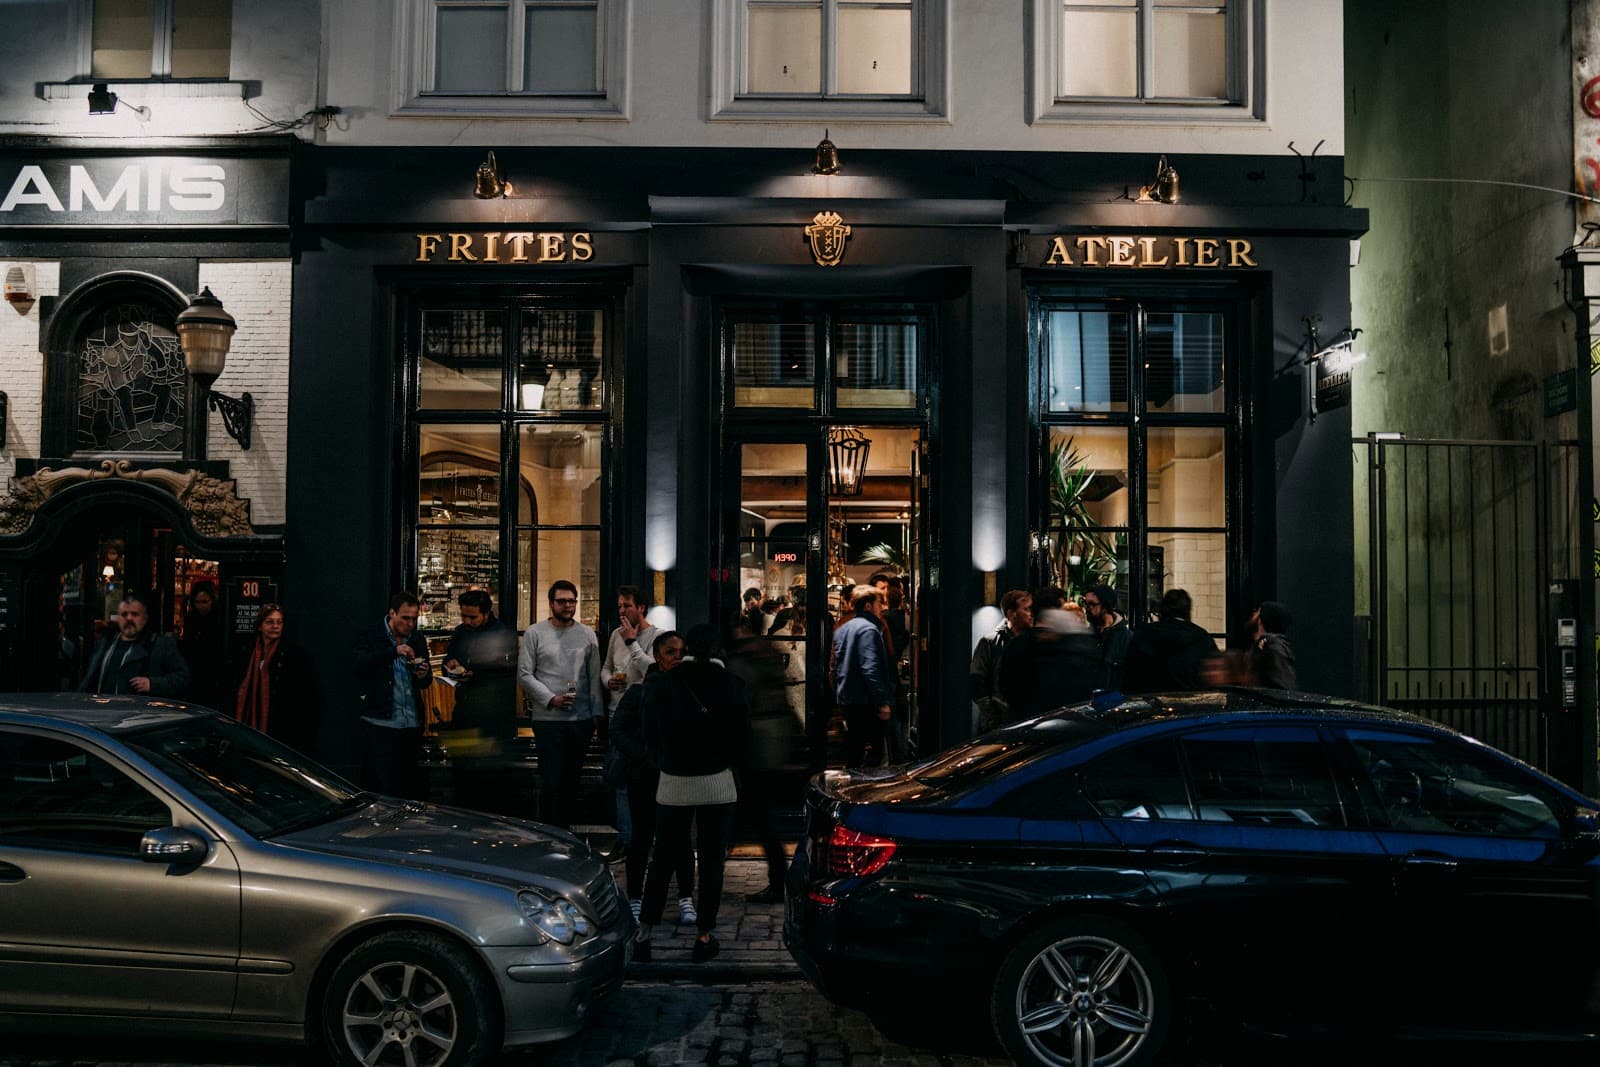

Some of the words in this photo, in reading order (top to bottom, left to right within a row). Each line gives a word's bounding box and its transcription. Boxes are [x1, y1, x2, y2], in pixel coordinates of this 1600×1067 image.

[0, 164, 226, 212] AMIS
[416, 232, 594, 263] FRITES
[1046, 236, 1257, 269] ATELIER
[243, 582, 258, 597] 30
